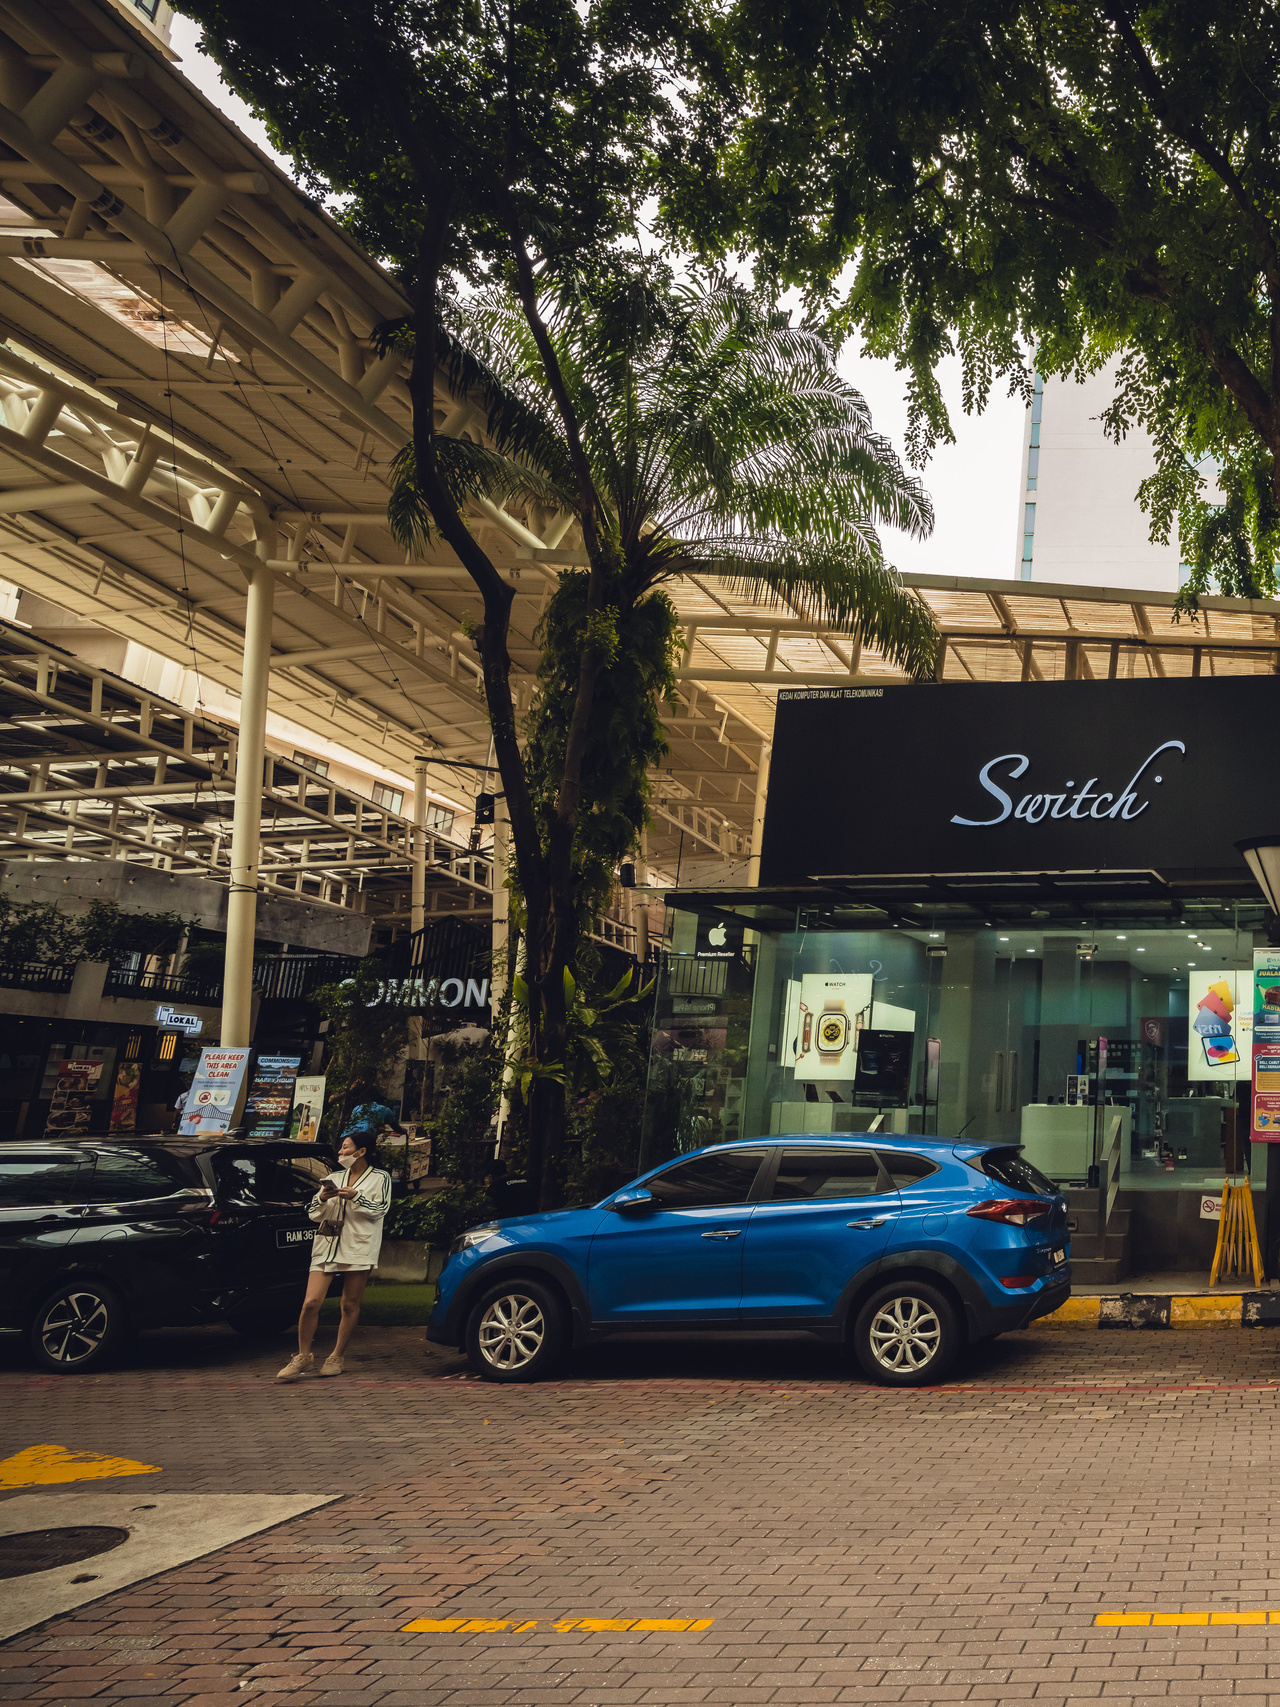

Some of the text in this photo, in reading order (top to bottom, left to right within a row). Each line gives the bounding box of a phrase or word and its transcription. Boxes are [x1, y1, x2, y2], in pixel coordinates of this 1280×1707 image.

[779, 688, 884, 700] KEDAI KOMPUTER DAN ALAT TELEKOMUNIKASI
[950, 740, 1186, 826] Switch
[169, 1015, 196, 1025] LOKAL
[204, 1053, 245, 1061] PLEASE KEEP
[286, 1231, 303, 1243] RAM
